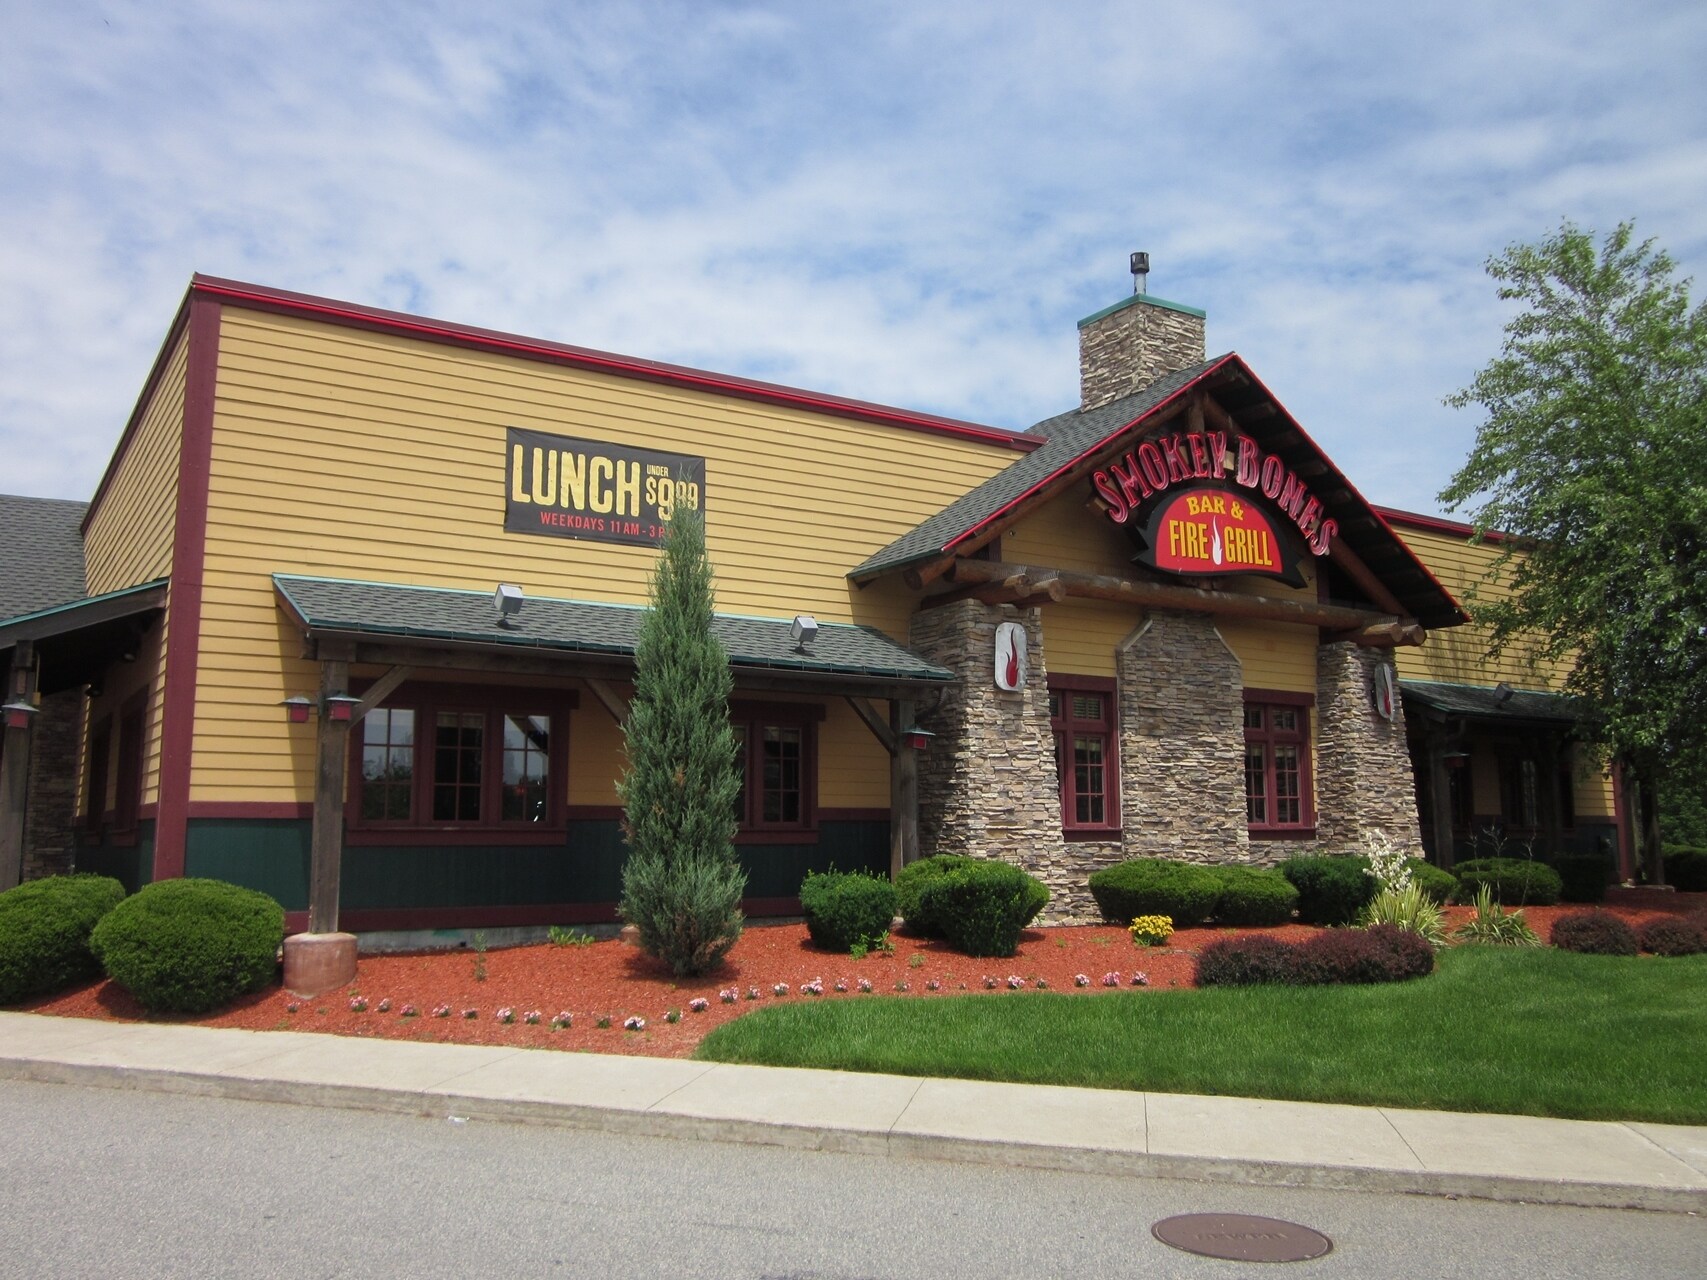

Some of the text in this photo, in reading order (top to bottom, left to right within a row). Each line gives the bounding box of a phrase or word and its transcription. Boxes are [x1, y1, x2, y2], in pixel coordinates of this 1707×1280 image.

[512, 444, 641, 517] LUNCH
[646, 464, 669, 477] UNDER
[1093, 431, 1339, 556] SMOKEY BONES
[1186, 496, 1244, 521] BAR &
[541, 511, 605, 532] WEEKDAYS
[1169, 520, 1272, 566] FIRE GRILL
